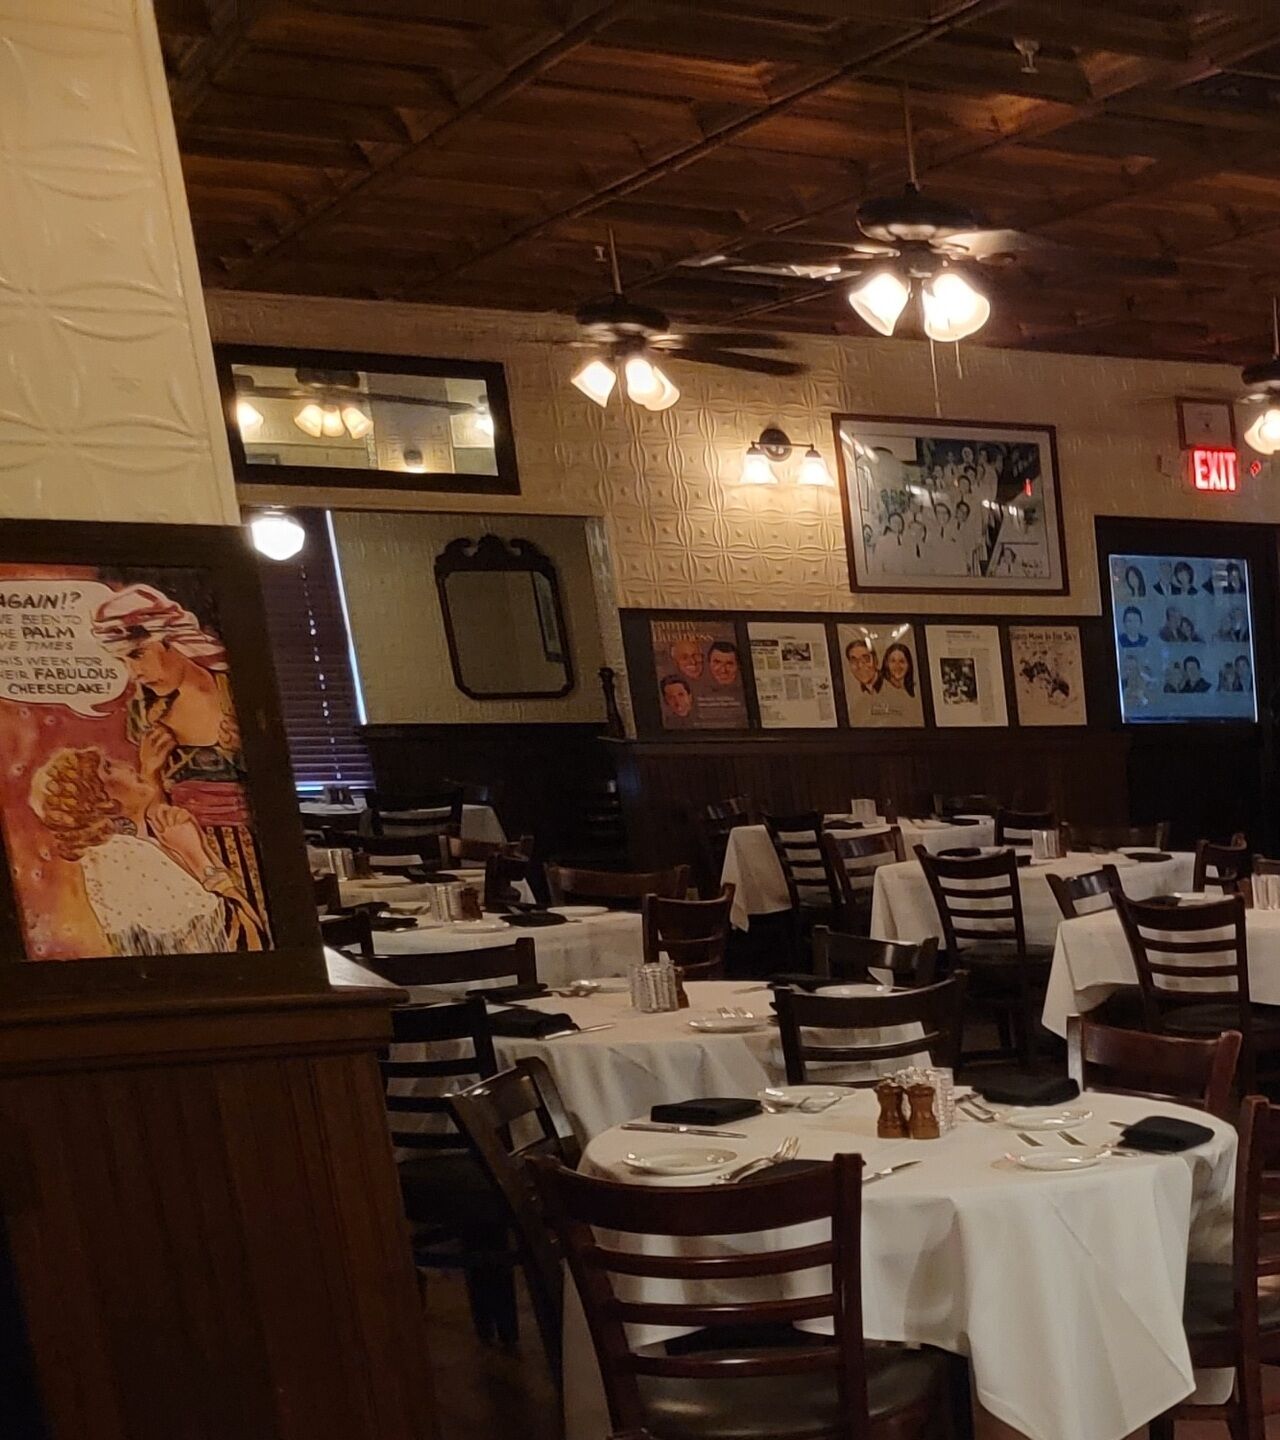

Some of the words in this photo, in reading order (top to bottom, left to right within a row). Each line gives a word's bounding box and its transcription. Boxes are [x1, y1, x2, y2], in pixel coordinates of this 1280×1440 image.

[1193, 450, 1236, 491] EXIT
[21, 626, 75, 639] PALM
[25, 641, 74, 651] TIMES
[27, 656, 71, 666] WEEK
[74, 656, 102, 667] FOR
[32, 667, 118, 680] FABULOUS
[8, 682, 111, 695] CHEESECAKE!
